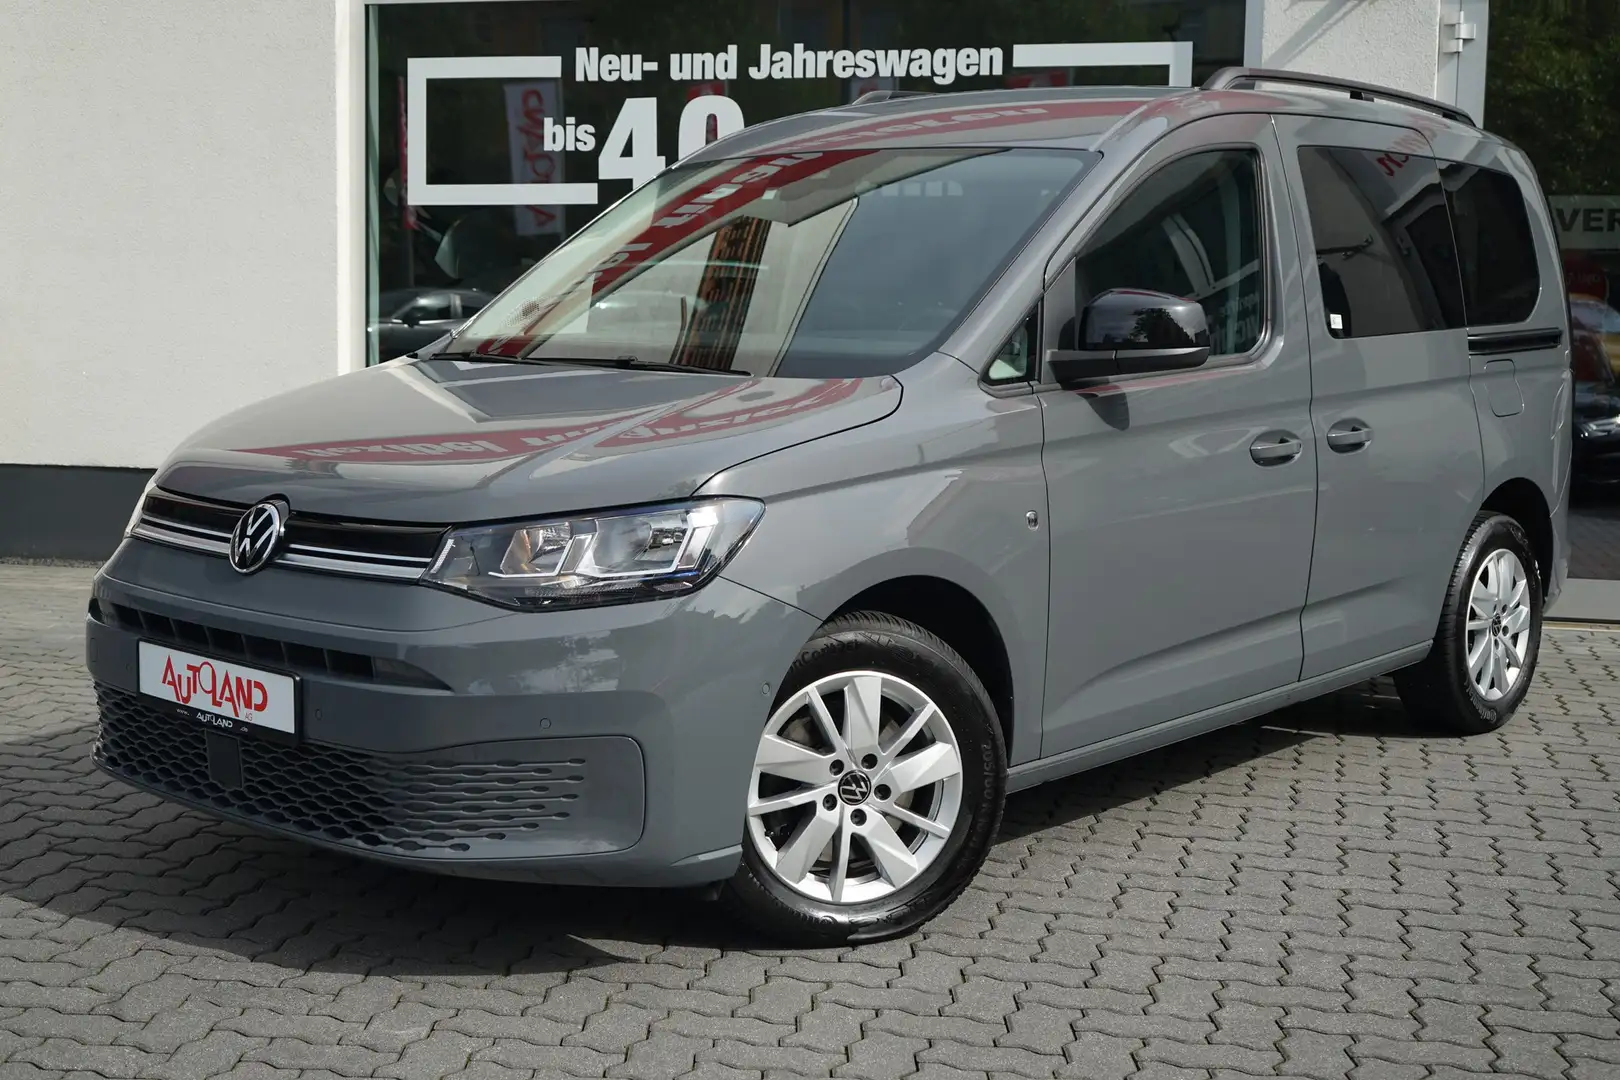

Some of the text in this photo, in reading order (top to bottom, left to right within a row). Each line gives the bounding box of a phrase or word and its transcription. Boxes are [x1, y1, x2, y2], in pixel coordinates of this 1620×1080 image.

[575, 43, 1003, 85] Neu- und Jahreswagen
[543, 116, 596, 152] bis
